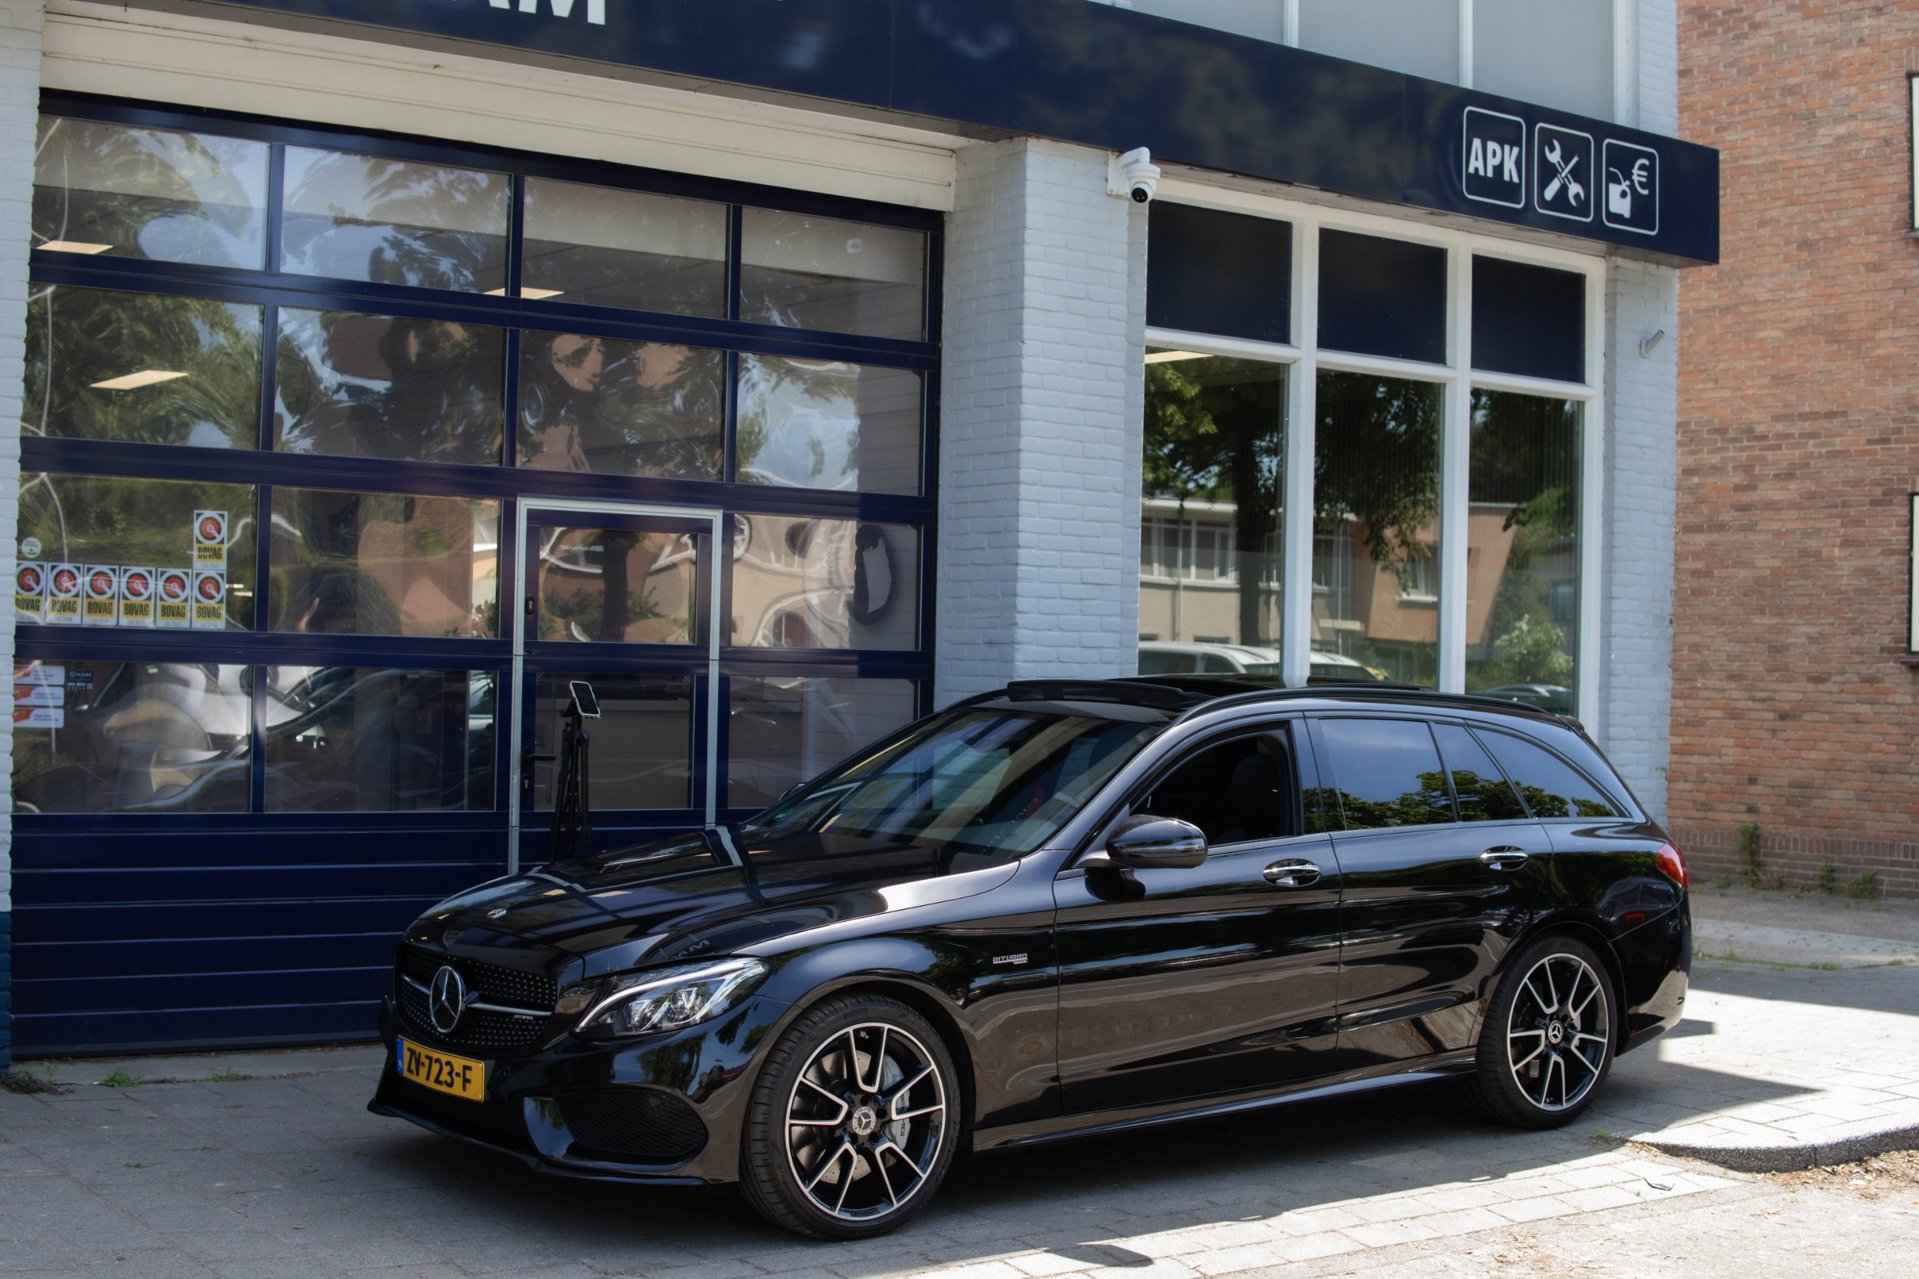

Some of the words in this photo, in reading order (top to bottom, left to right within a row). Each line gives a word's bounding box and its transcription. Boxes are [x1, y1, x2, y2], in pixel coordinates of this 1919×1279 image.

[1468, 137, 1520, 184] APK
[197, 546, 222, 560] BOVAG
[87, 601, 113, 615] BOVAG
[124, 603, 149, 616] BOVAG
[161, 604, 186, 618] BOVAG
[196, 606, 222, 619] BOVAG
[407, 1047, 472, 1092] ZN-723-F
